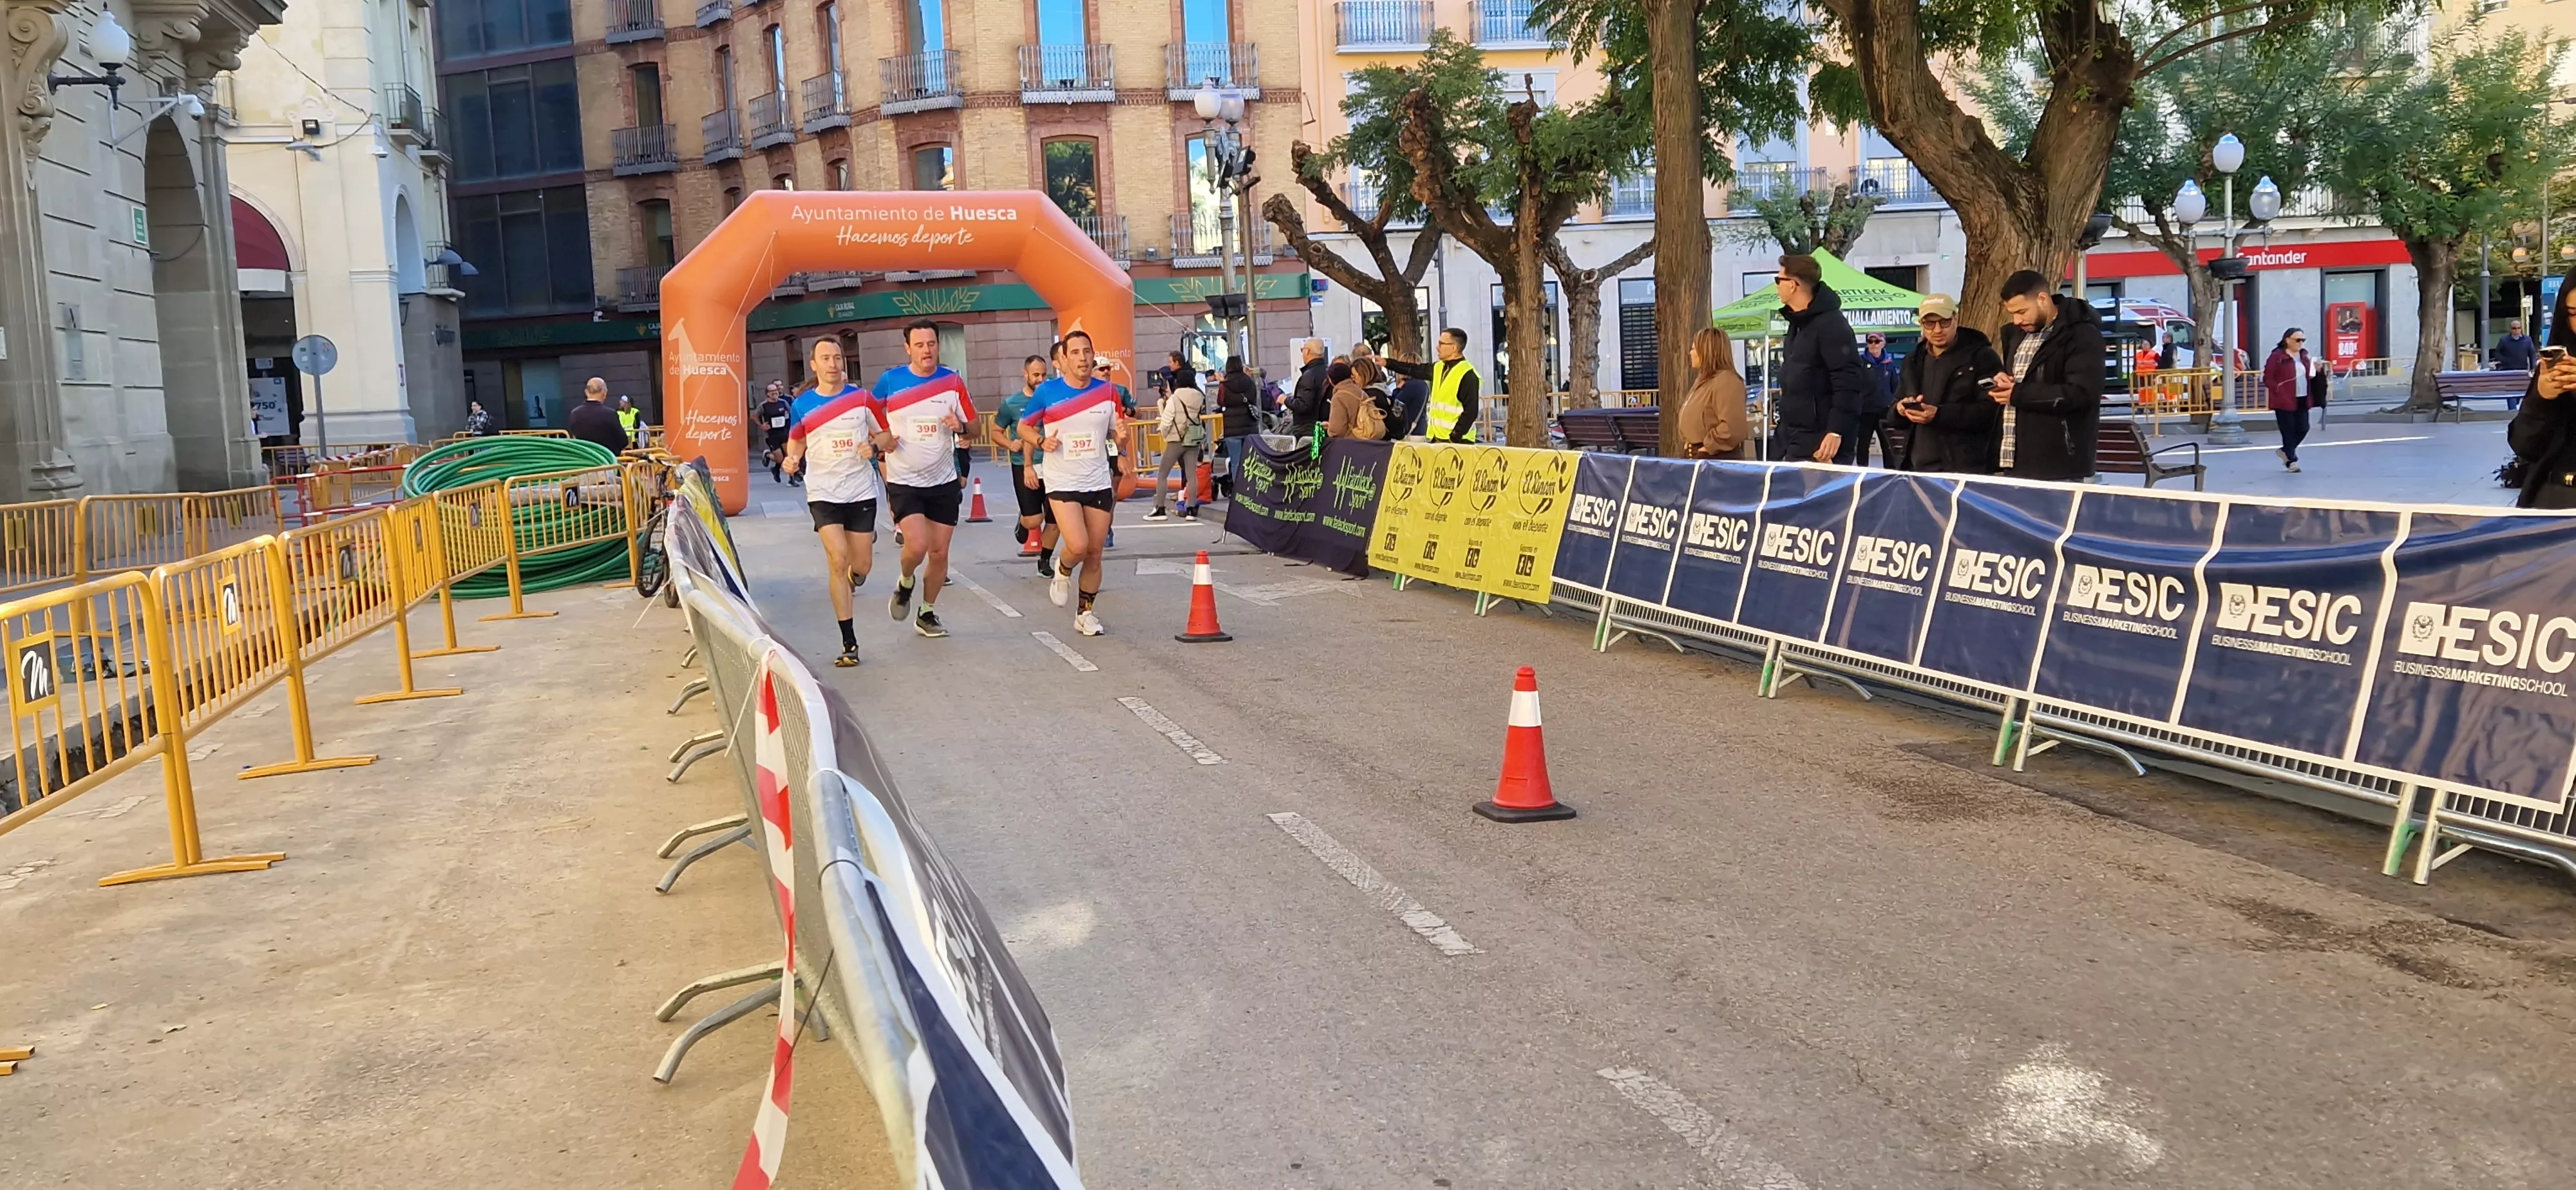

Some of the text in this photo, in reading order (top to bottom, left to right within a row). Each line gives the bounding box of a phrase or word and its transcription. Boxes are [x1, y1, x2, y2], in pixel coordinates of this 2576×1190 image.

[791, 205, 1017, 224] Ayuntamiento de Huesca
[836, 224, 974, 252] Hacemos deporte
[1895, 255, 1900, 265] 2
[1842, 310, 1911, 326] TUALLAMIENTO
[669, 351, 740, 366] Ayuntamiento
[669, 364, 726, 375] de Huesca
[685, 409, 737, 426] Hacemos
[916, 424, 937, 433] 398
[685, 425, 732, 446] deporte
[831, 439, 853, 449] 396
[1072, 439, 1092, 448] 397
[1580, 495, 1616, 528] ESIC
[1636, 505, 1678, 540] ESIC
[1701, 514, 1748, 552] ESIC
[1777, 525, 1835, 566] ESIC
[1869, 537, 1931, 581] ESIC
[1971, 552, 2046, 600] ESIC
[2096, 567, 2185, 621] ESIC
[2250, 585, 2362, 645] ESIC
[2440, 606, 2576, 674] ESIC
